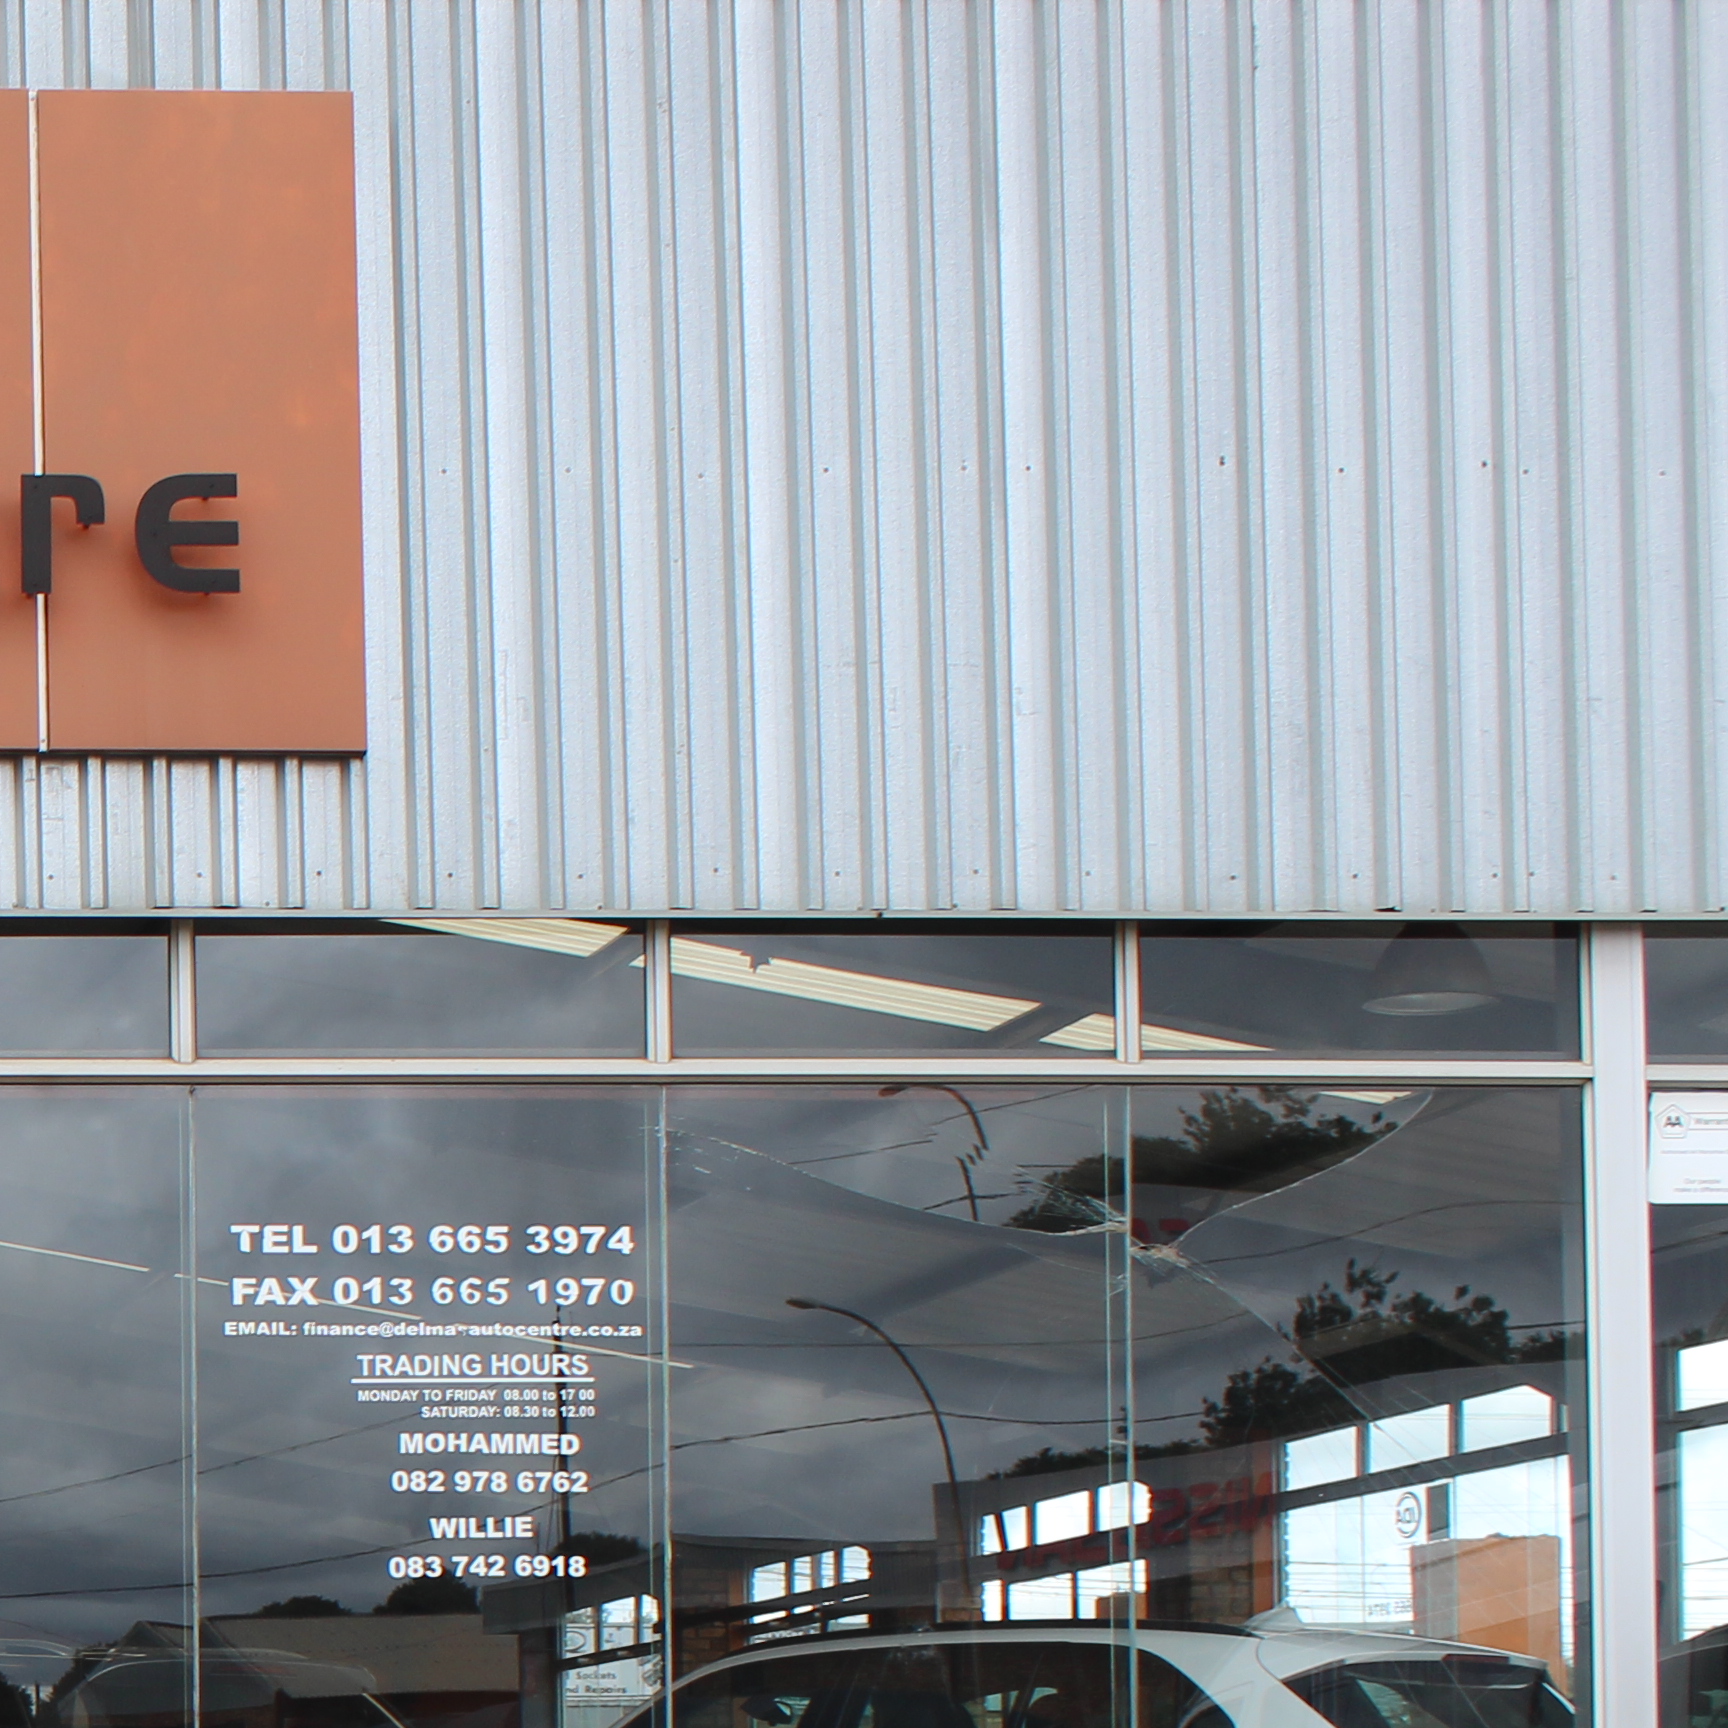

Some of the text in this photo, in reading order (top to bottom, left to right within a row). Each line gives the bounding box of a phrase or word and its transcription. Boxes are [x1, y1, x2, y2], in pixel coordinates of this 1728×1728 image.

[229, 1224, 635, 1255] TEL 013 665 3974
[231, 1276, 635, 1306] FAX 013 665 1970
[224, 1321, 298, 1336] EMAIL:
[356, 1354, 589, 1377] TRADING HOURS
[357, 1389, 419, 1401] MONDAY
[422, 1389, 442, 1401] TO
[445, 1389, 497, 1401] FRIDAY
[542, 1389, 557, 1400] to
[420, 1405, 596, 1418] SATURDAY: 08.30 to 12.00
[398, 1432, 582, 1455] MOHAMMED
[390, 1470, 589, 1493] 082 978 6762
[429, 1516, 534, 1539] WILLIE
[388, 1555, 587, 1578] 083 742 6918
